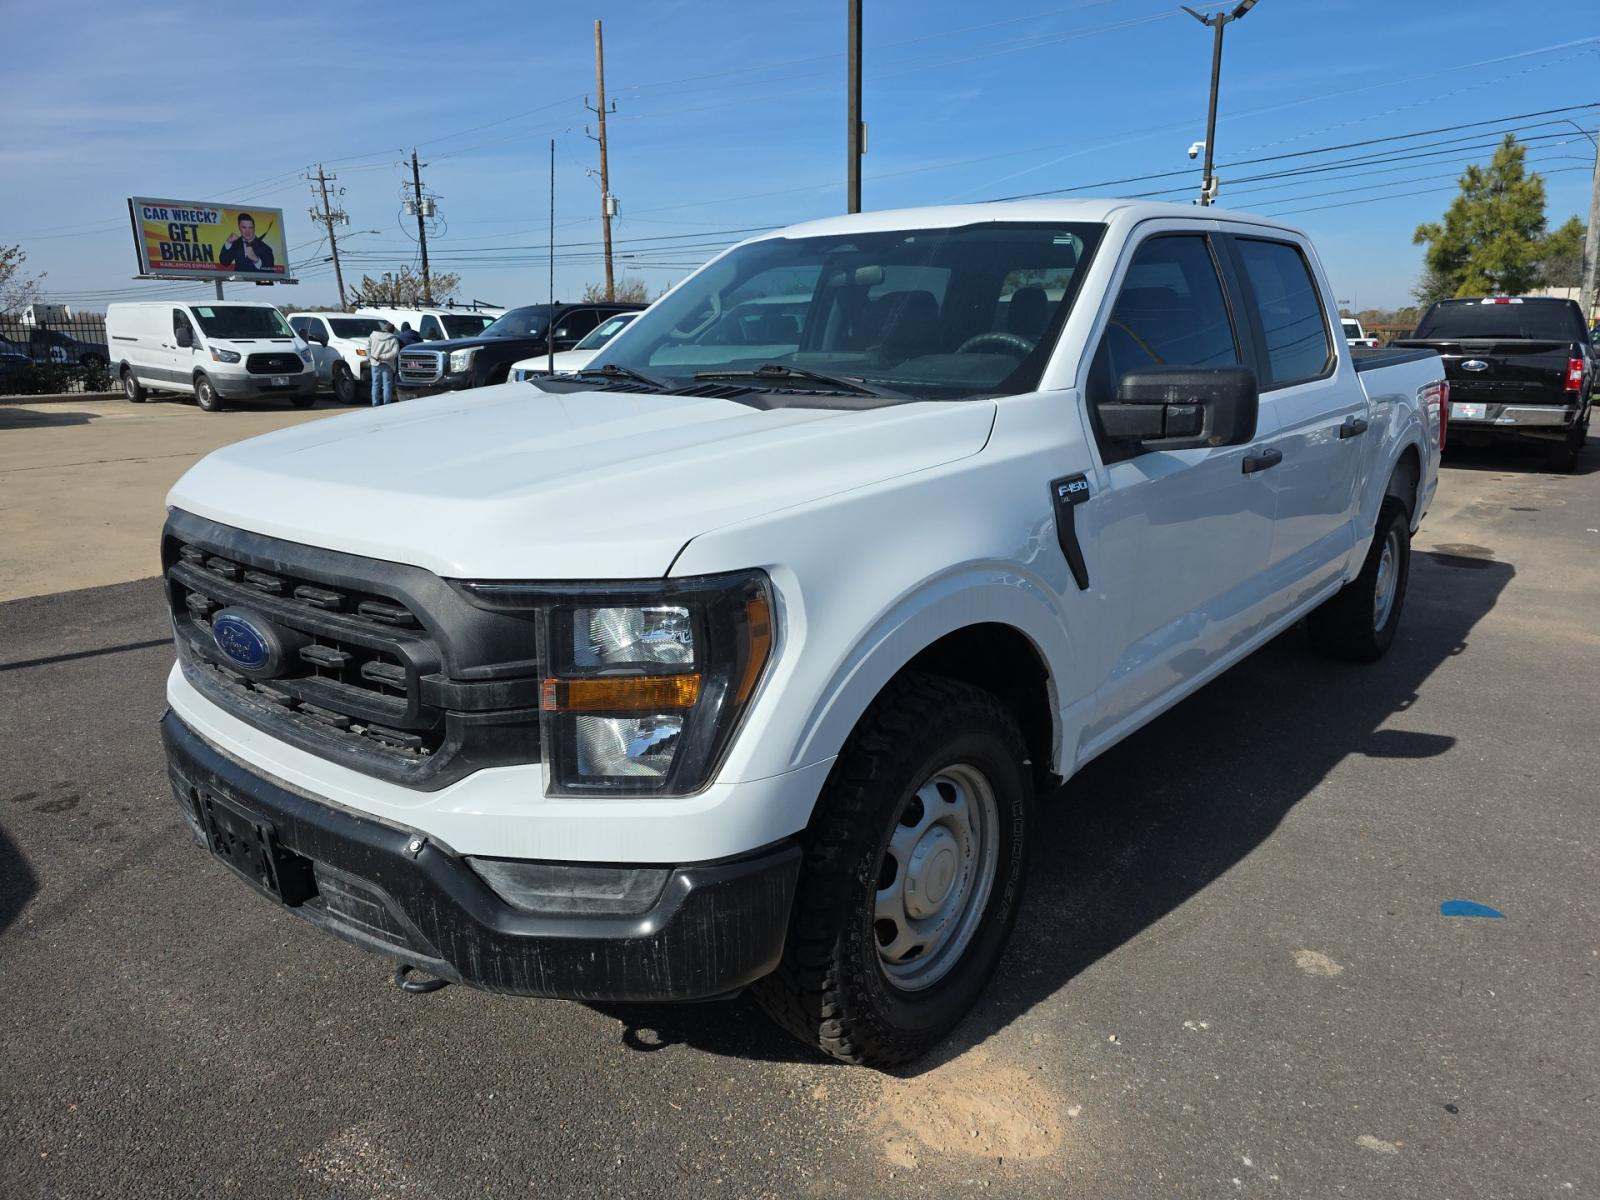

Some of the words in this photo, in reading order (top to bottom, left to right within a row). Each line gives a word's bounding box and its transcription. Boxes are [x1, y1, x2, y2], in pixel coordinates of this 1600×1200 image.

[144, 207, 168, 220] CAR
[172, 209, 217, 223] WRECK?
[168, 223, 199, 242] GET
[160, 242, 214, 261] BRIAN
[1059, 481, 1088, 496] F-150
